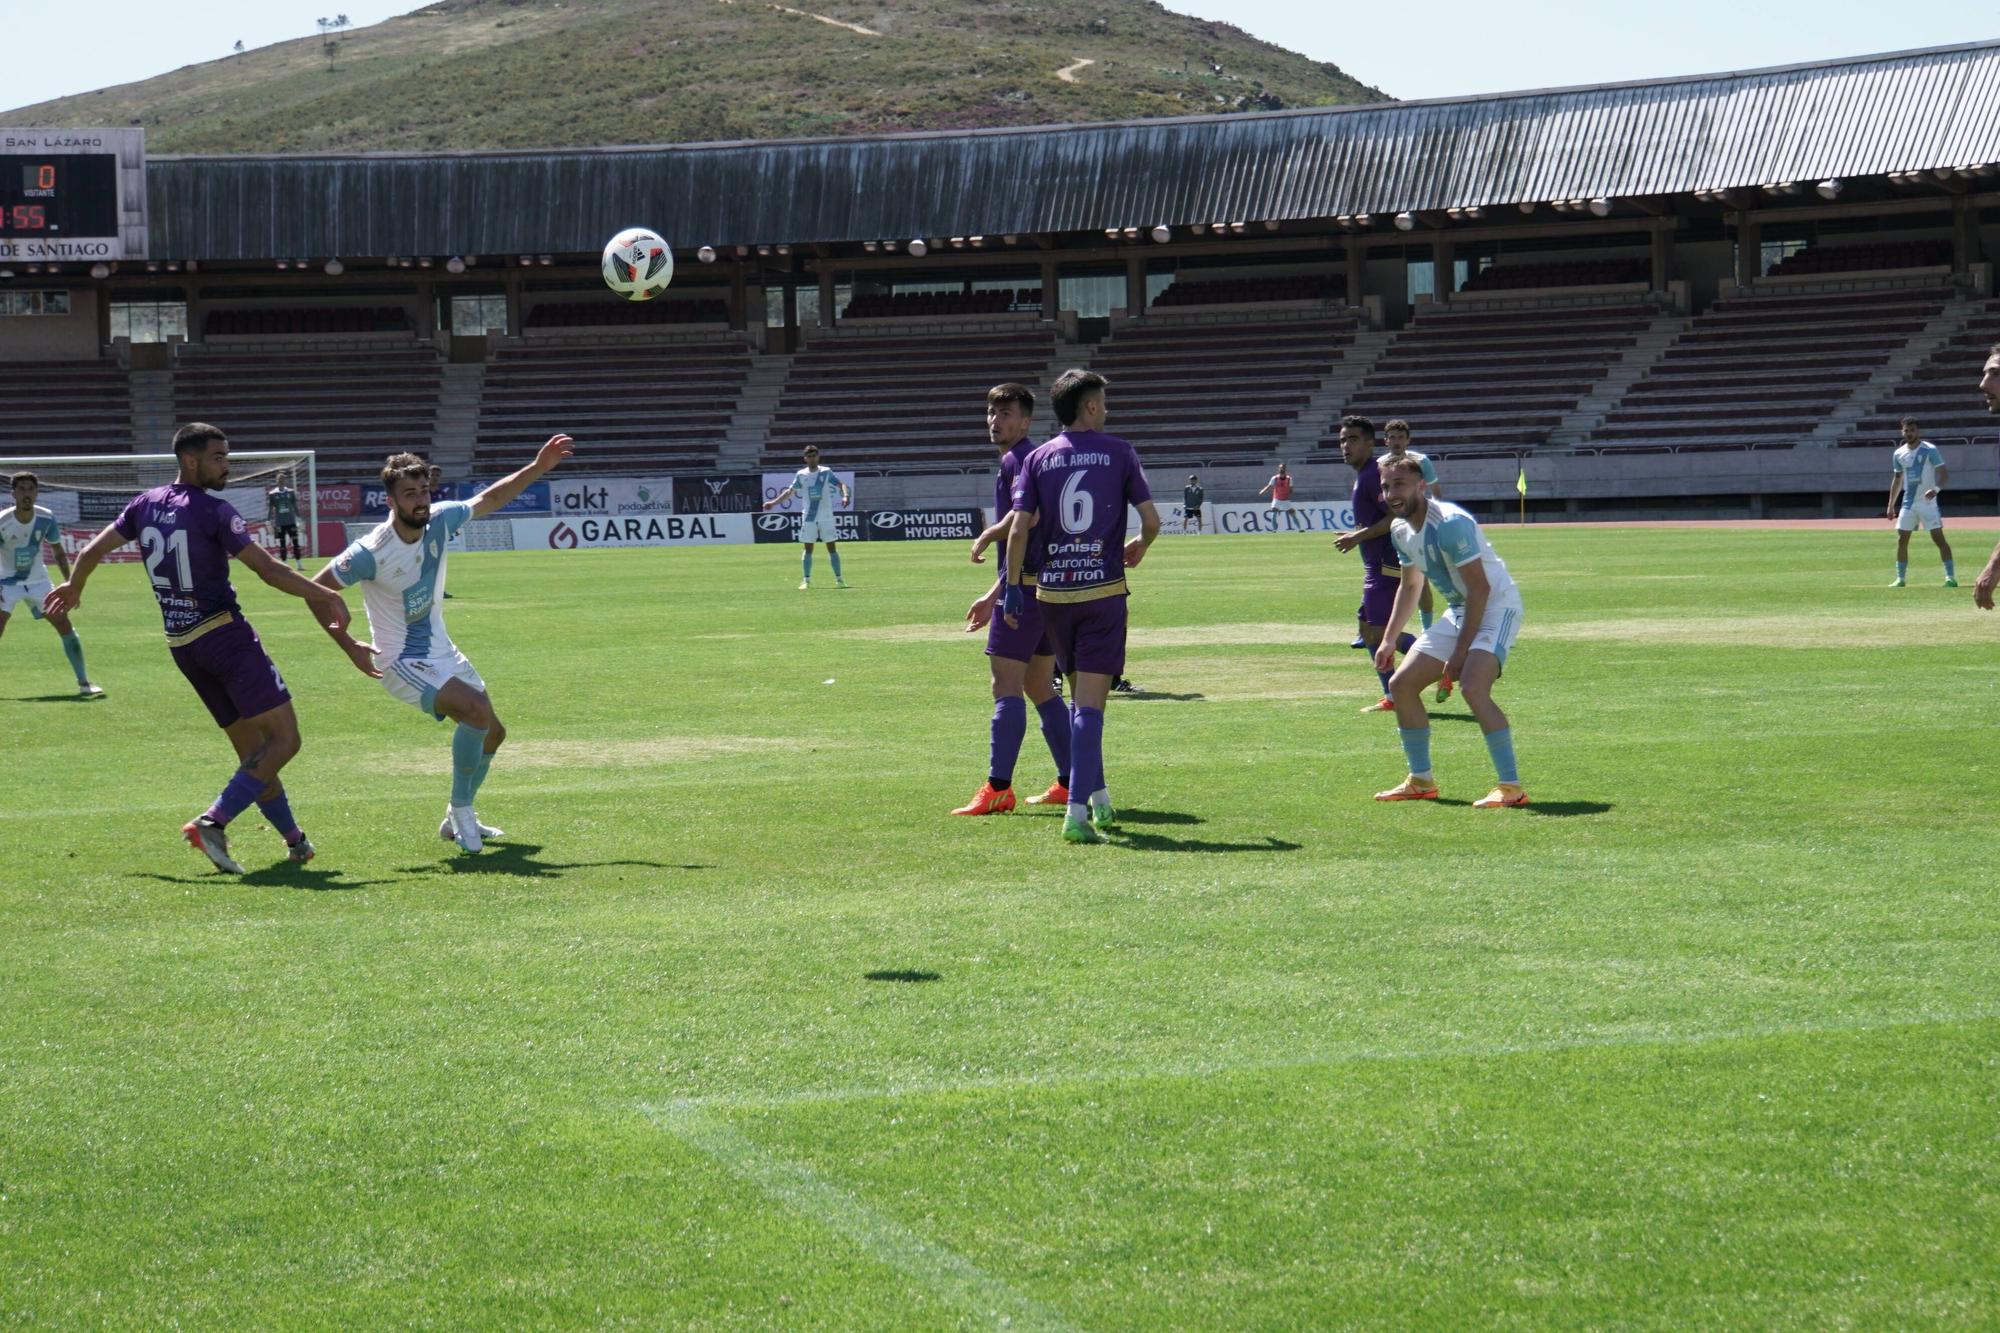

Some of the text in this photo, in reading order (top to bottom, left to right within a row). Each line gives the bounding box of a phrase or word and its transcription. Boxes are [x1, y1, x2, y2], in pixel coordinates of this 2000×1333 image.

[38, 165, 55, 188] 0
[24, 189, 55, 197] VISITANTE
[0, 205, 45, 229] :55
[1, 243, 109, 256] DE SANTIAGO
[1070, 453, 1110, 467] ARROYO
[564, 485, 608, 509] akt
[617, 500, 671, 514] podoactiva
[693, 492, 752, 512] VAQUIÑA
[1059, 470, 1094, 535] 6
[582, 516, 726, 542] GARABAL
[903, 513, 972, 525] HYUNDAI
[905, 525, 972, 538] HYUPERSA
[141, 526, 194, 592] 21
